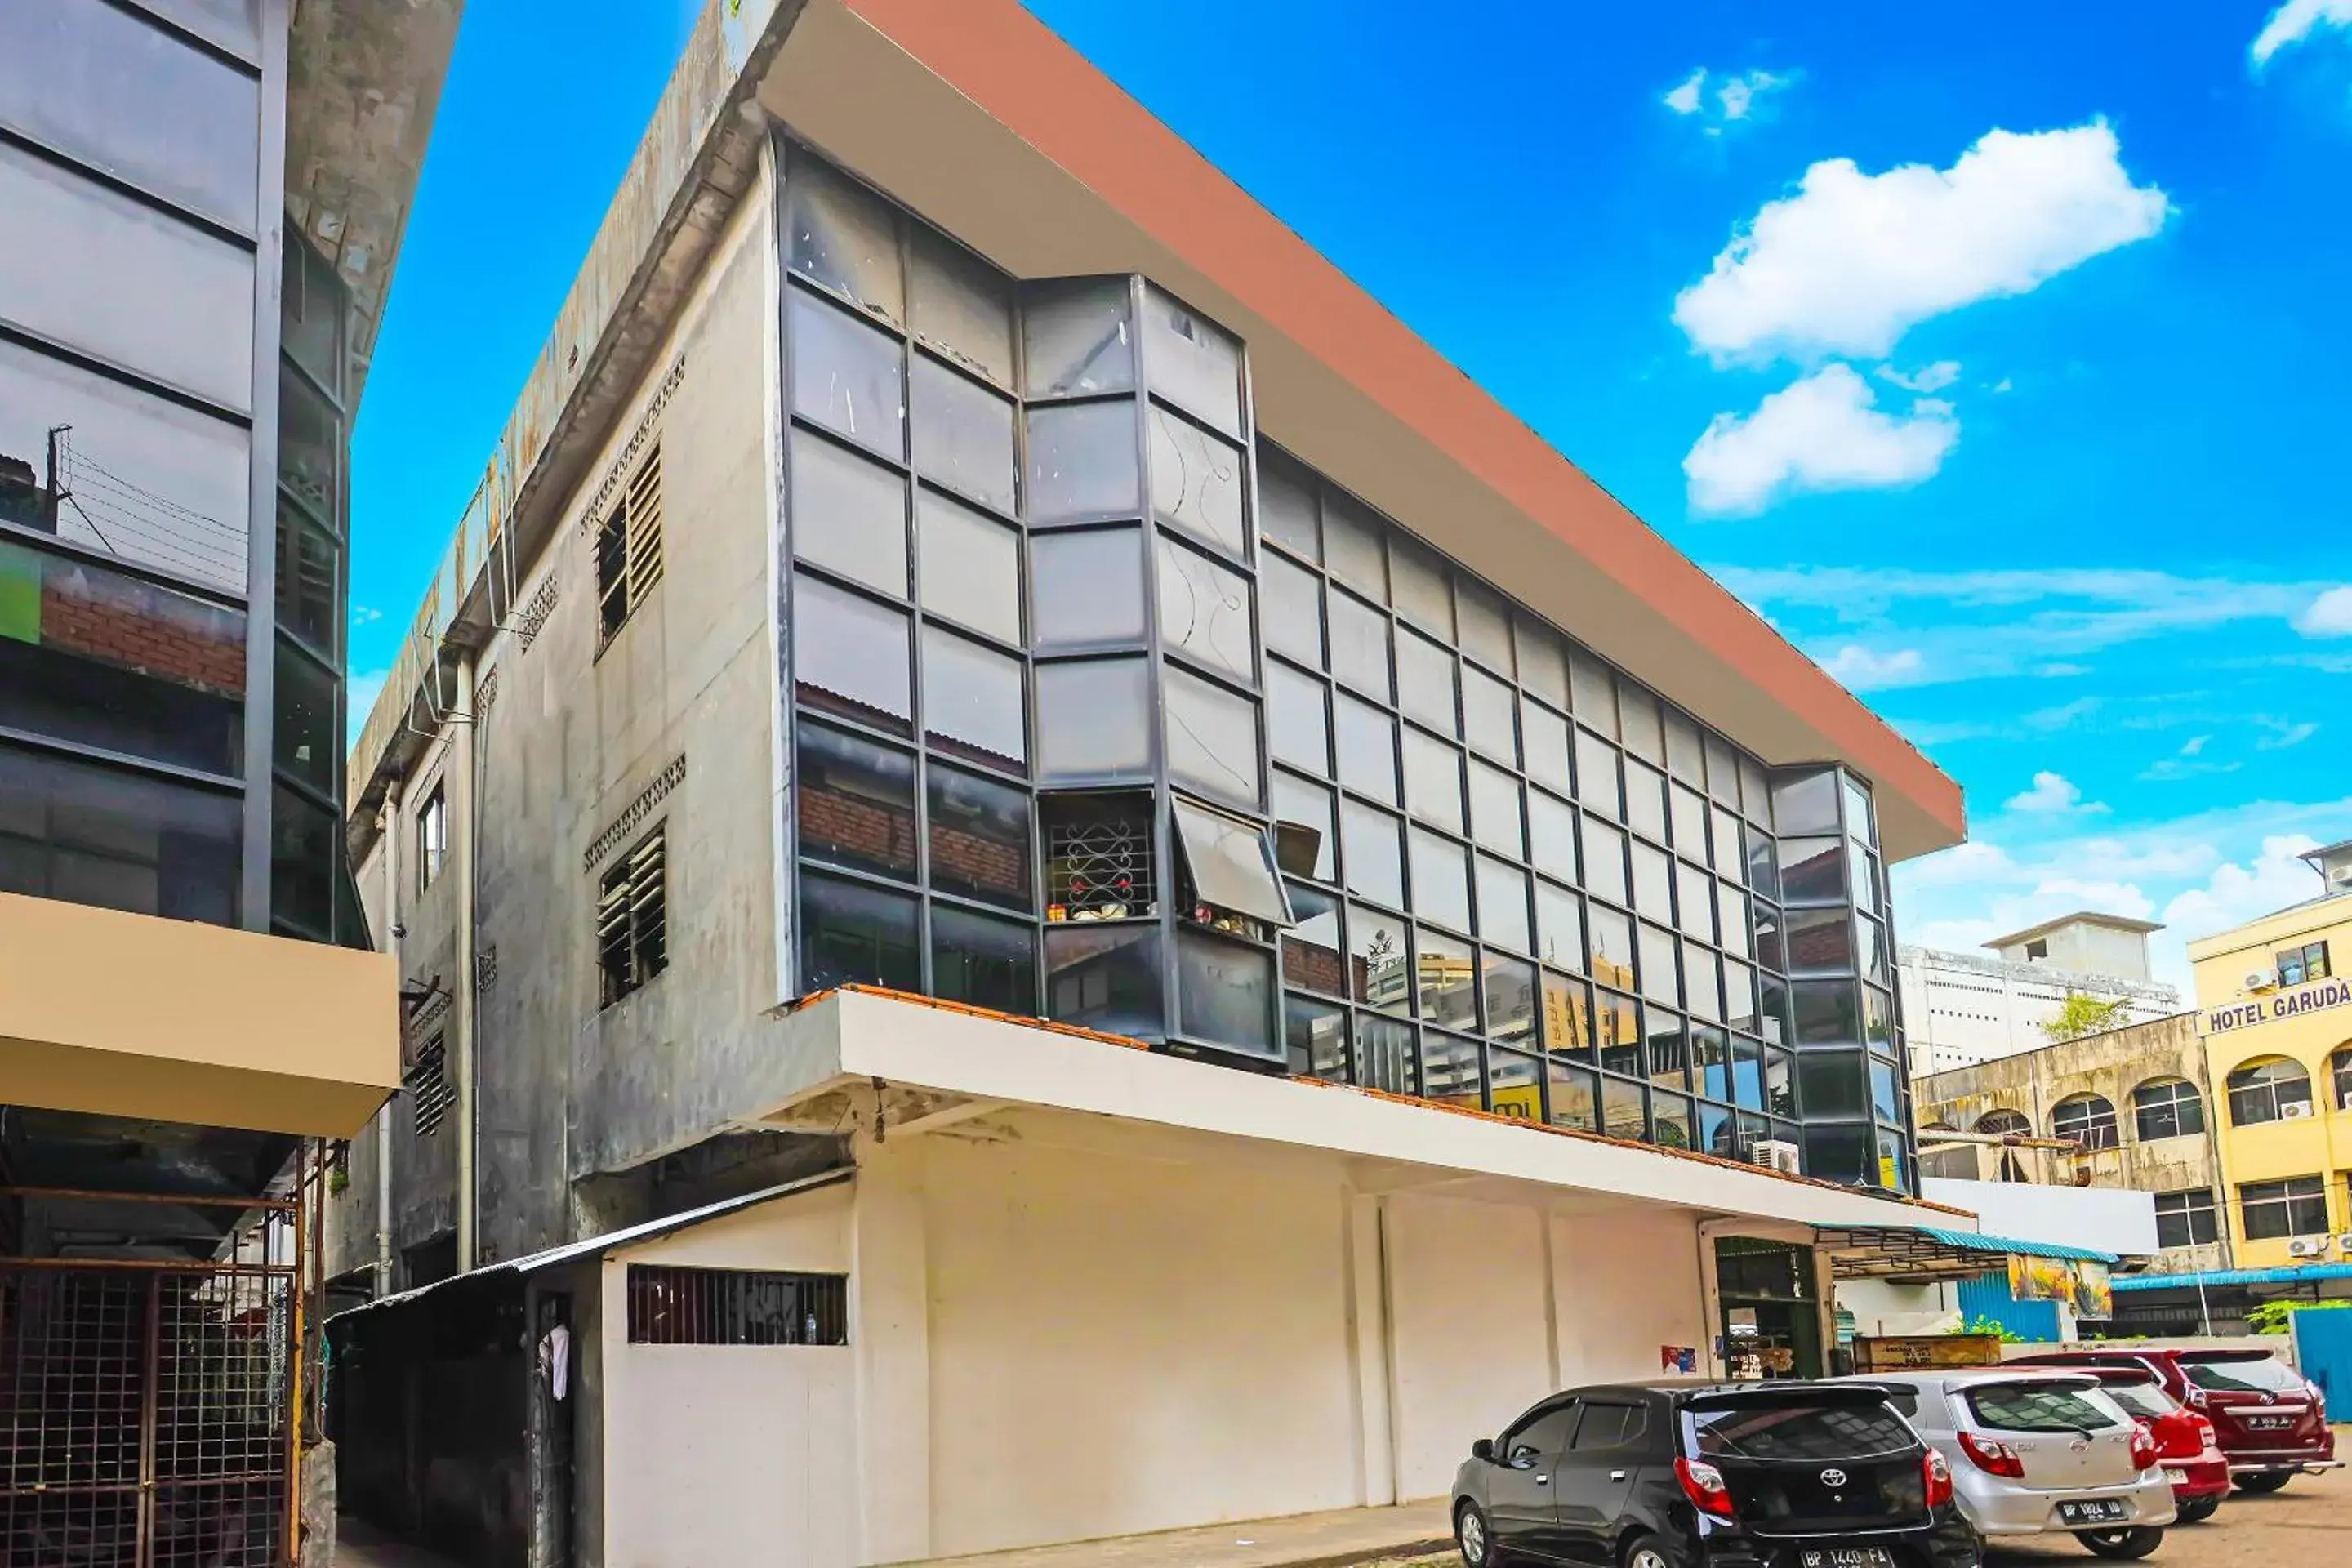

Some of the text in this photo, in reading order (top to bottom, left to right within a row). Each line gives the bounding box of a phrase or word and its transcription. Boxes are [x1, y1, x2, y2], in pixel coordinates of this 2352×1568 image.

[2210, 982, 2351, 1032] HOTEL GARUDA
[1805, 1548, 1887, 1567] BP 1440 FA
